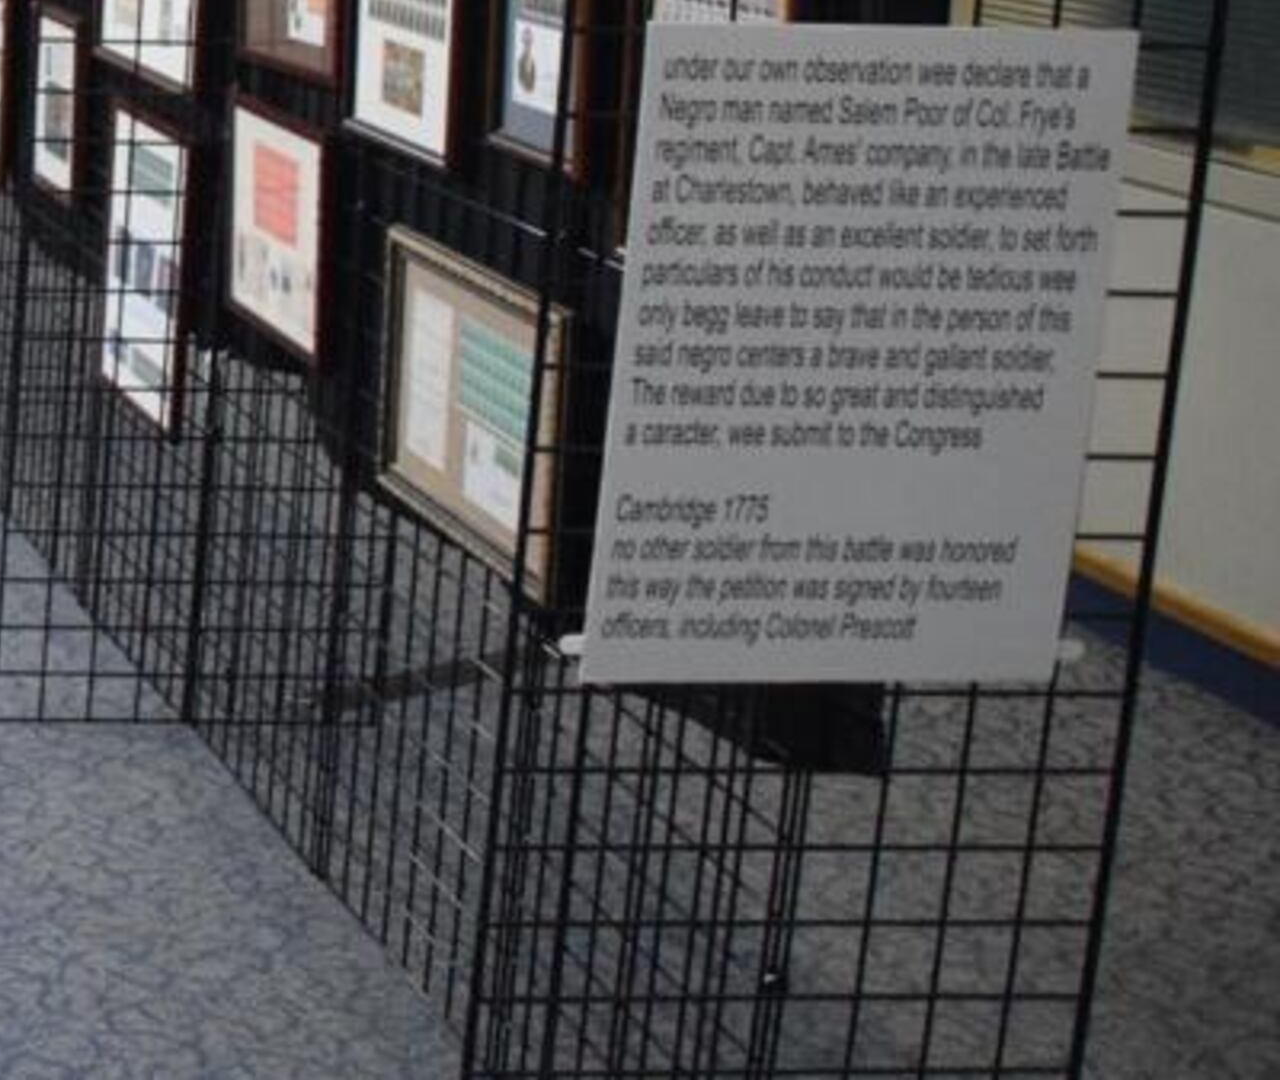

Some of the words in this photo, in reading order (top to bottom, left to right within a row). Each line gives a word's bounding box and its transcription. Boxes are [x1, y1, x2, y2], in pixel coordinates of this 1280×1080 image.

[663, 53, 717, 79] under
[722, 60, 754, 80] our
[759, 61, 799, 81] own
[803, 56, 912, 83] observation
[918, 65, 957, 84] wee
[961, 60, 1031, 86] declare
[1035, 61, 1074, 87] that
[1077, 68, 1091, 87] a
[658, 94, 718, 127] Negro
[721, 101, 763, 121] man
[768, 96, 835, 122] named
[839, 98, 898, 124] Salem
[902, 99, 948, 125] Poor
[952, 100, 973, 125] of
[959, 141, 979, 166] in
[982, 141, 1012, 167] the
[651, 176, 671, 201] at
[802, 178, 884, 205] behaved
[888, 180, 921, 206] like
[924, 187, 949, 206] an
[953, 181, 1069, 216] experienced
[714, 226, 737, 245] as
[742, 220, 780, 246] well
[783, 227, 807, 246] as
[811, 227, 836, 246] an
[840, 222, 925, 248] excellent
[998, 224, 1019, 249] to
[1022, 224, 1052, 249] set
[1054, 224, 1100, 250] forth
[640, 258, 740, 292] particulars
[743, 260, 764, 285] of
[767, 260, 795, 286] his
[798, 261, 875, 287] conduct
[878, 262, 934, 288] would
[937, 263, 962, 289] be
[1038, 271, 1077, 291] wee
[637, 299, 678, 332] only
[682, 300, 730, 332] begg
[734, 300, 785, 326] leave
[789, 301, 809, 327] to
[812, 308, 845, 334] say
[850, 302, 887, 328] that
[890, 303, 908, 328] in
[912, 303, 943, 329] the
[946, 310, 1011, 337] person
[1015, 305, 1036, 330] of
[1038, 305, 1072, 330] this
[633, 340, 674, 365] said
[677, 346, 732, 373] negro
[810, 348, 823, 367] a
[827, 342, 880, 368] brave
[885, 343, 921, 368] and
[923, 343, 988, 376] gallant
[633, 379, 667, 404] The
[670, 379, 737, 405] reward
[740, 380, 776, 406] due
[780, 381, 799, 406] to
[803, 387, 827, 407] so
[829, 382, 880, 414] great
[883, 382, 920, 408] and
[922, 383, 1045, 417] distinguished
[624, 425, 638, 444] a
[728, 426, 766, 445] wee
[770, 420, 833, 445] submit
[836, 421, 856, 446] to
[859, 421, 890, 446] the
[894, 421, 983, 454] Congress
[615, 495, 717, 528] Cambridge
[724, 496, 769, 521] 1775
[610, 539, 637, 559] no
[640, 534, 688, 559] other
[692, 534, 754, 560] soldier
[758, 535, 802, 560] from
[805, 535, 839, 561] this
[842, 536, 894, 561] battle
[899, 542, 936, 561] was
[940, 537, 1018, 562] honored
[605, 571, 640, 597] this
[645, 578, 681, 604] way
[685, 572, 716, 598] the
[719, 573, 787, 605] petition
[792, 579, 829, 599] was
[834, 574, 896, 606] signed
[898, 574, 922, 607] by
[679, 612, 762, 645] including
[765, 613, 836, 638] Colonel
[839, 613, 917, 639] Prescott
